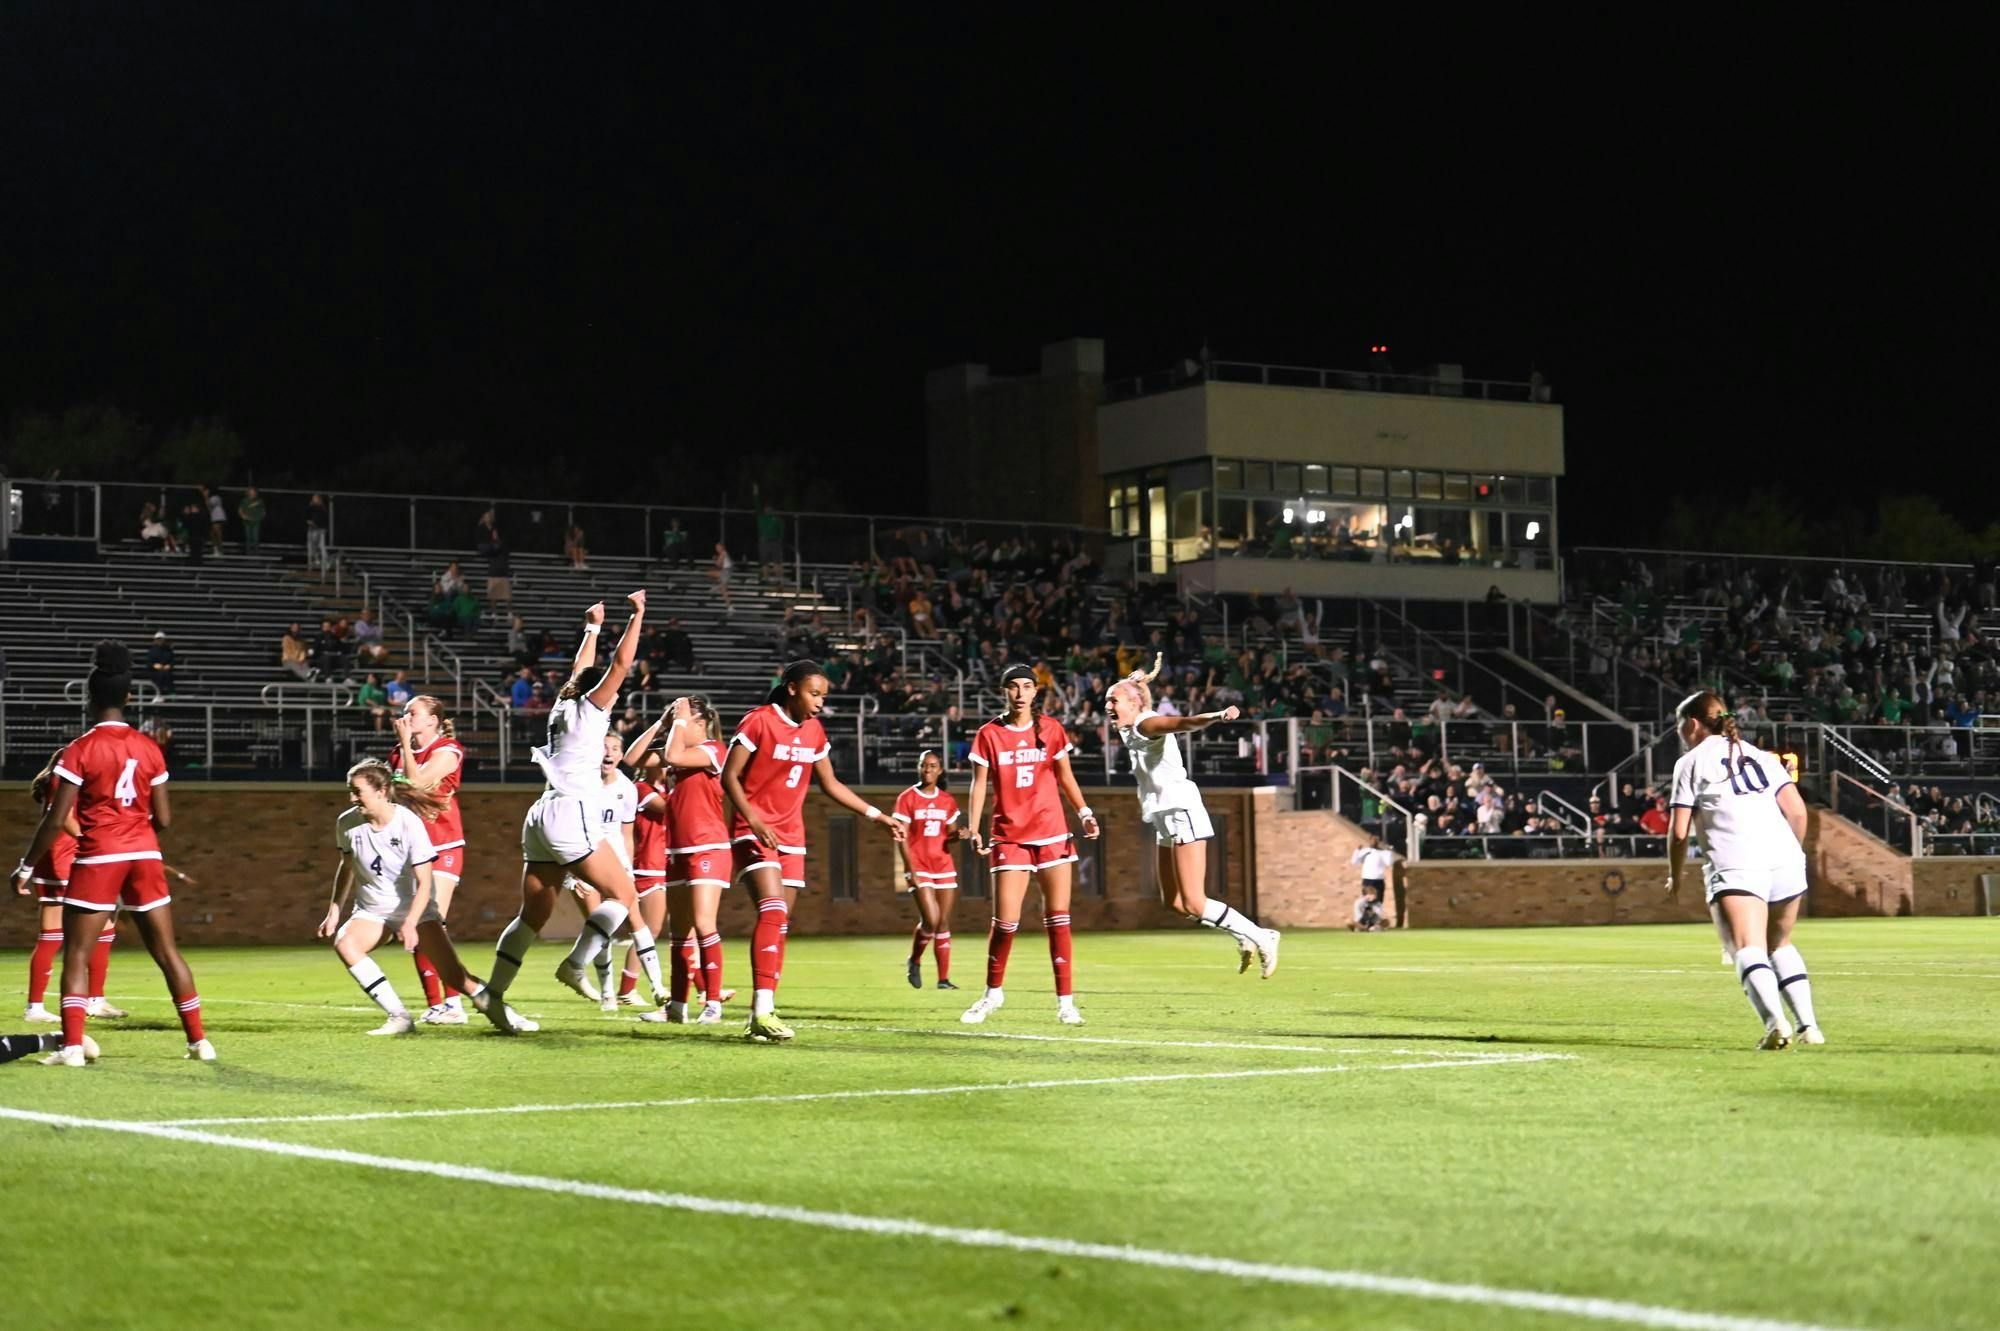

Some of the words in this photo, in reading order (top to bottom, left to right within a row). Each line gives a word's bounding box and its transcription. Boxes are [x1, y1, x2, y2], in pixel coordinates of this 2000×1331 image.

[998, 750, 1014, 765] NC
[1015, 748, 1047, 763] STATE
[114, 758, 139, 807] 4
[785, 764, 803, 788] 9
[1015, 764, 1035, 788] 15
[1720, 755, 1770, 795] 10
[370, 855, 382, 876] 4
